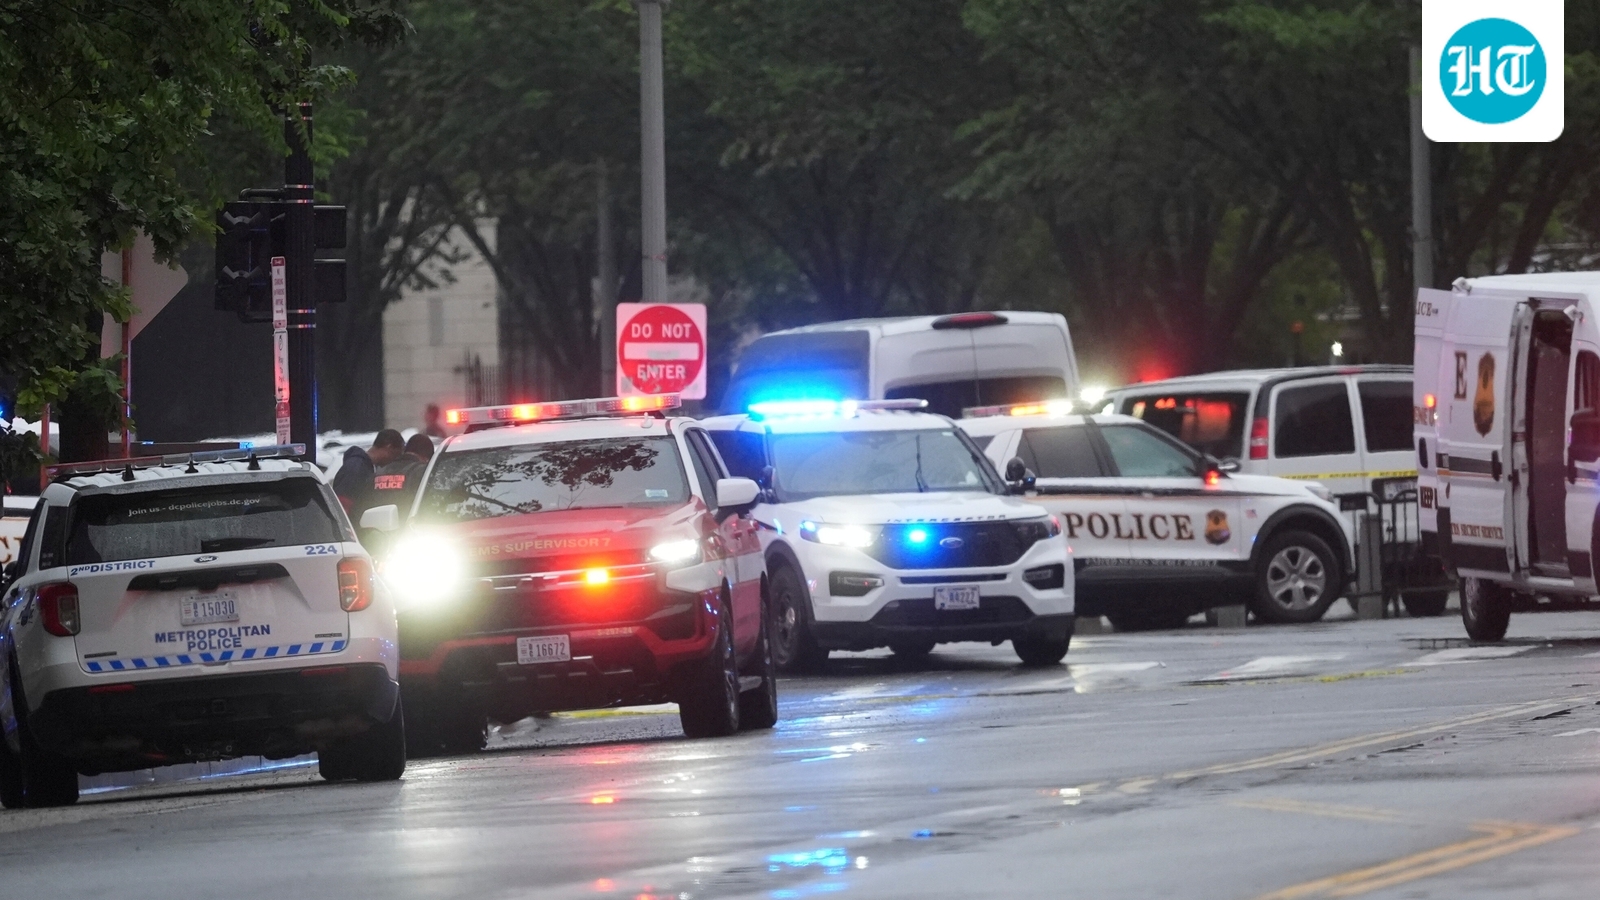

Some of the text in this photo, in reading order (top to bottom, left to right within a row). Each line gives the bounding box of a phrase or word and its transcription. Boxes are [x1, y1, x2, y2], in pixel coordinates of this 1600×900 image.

[631, 323, 692, 338] DO NOT
[637, 364, 686, 379] ENTER
[374, 481, 403, 489] POLICE
[128, 508, 148, 517] Join
[168, 498, 261, 511] dcpolicejobs.dc.gov
[1062, 512, 1195, 541] POLICE
[304, 545, 338, 555] 224
[470, 537, 611, 556] EMS SUPERVISOR 7
[202, 600, 235, 617] 15030
[155, 625, 271, 643] METROPOLITAN
[187, 637, 242, 651] POLICE
[536, 642, 566, 657] 16672
